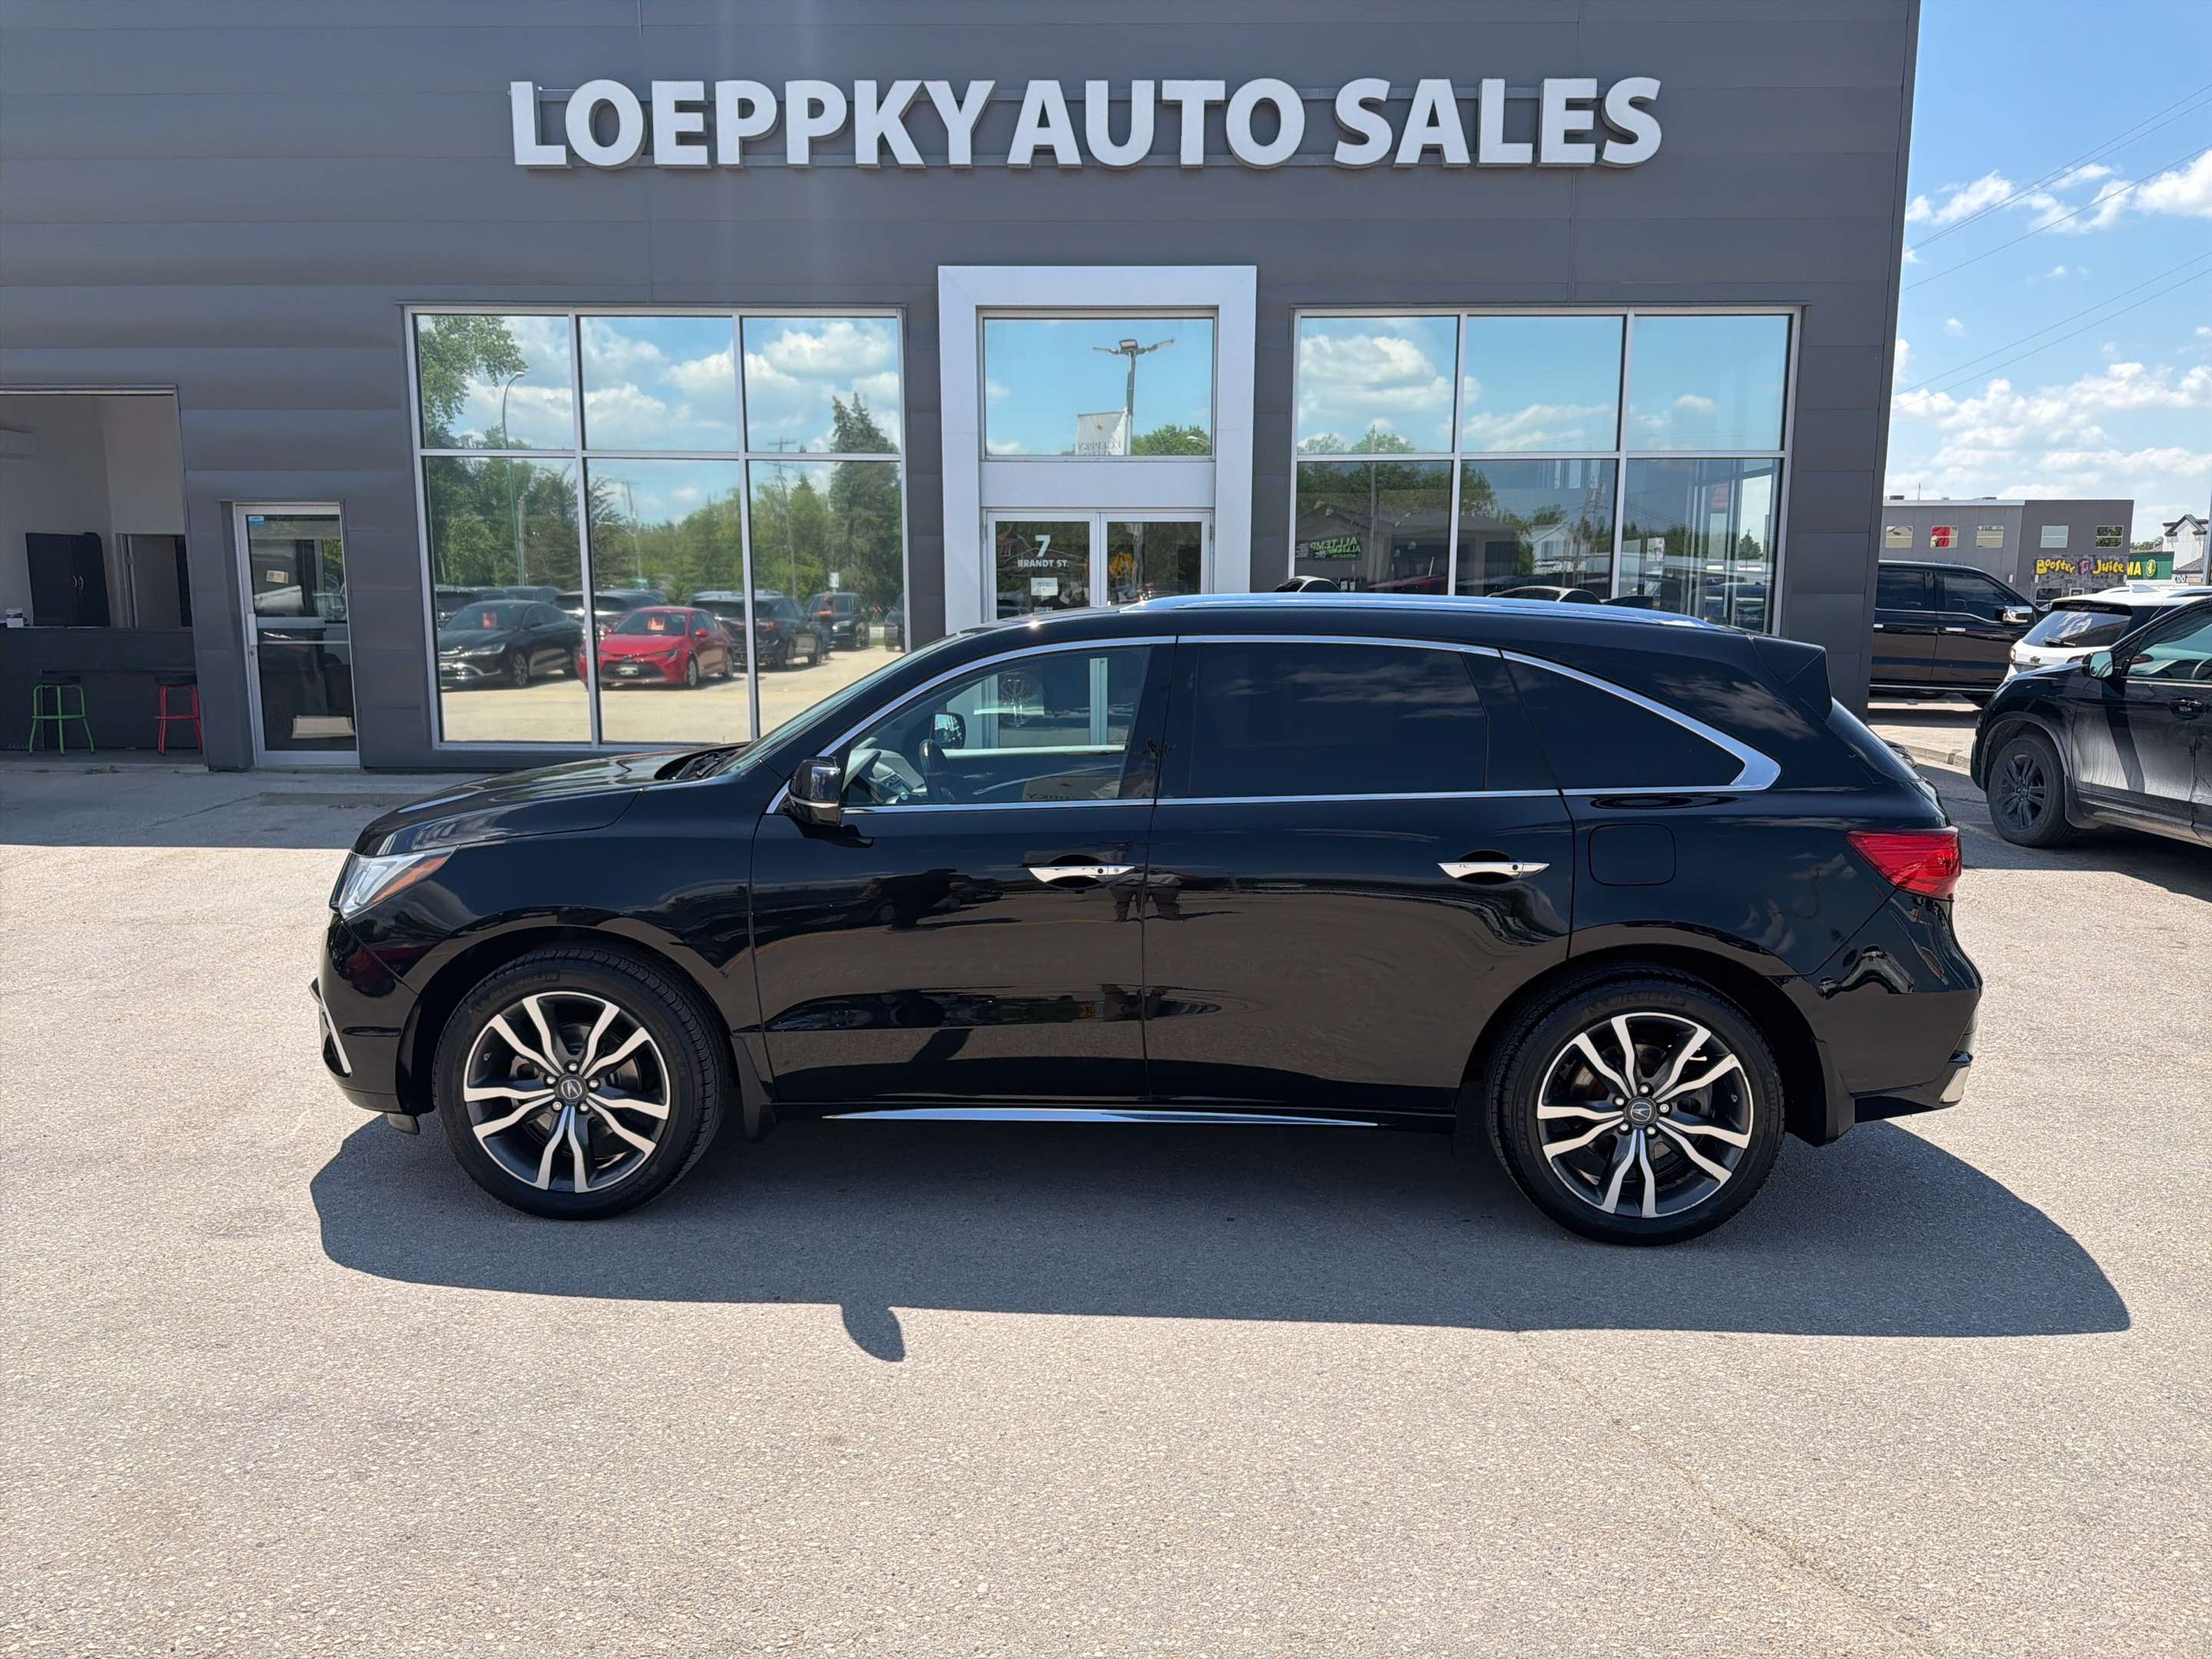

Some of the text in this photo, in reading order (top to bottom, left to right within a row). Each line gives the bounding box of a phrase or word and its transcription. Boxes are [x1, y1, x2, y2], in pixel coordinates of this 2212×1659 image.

[509, 77, 1663, 168] LOEPPKY AUTO SALES
[1035, 535, 1051, 558] 7
[1017, 558, 1070, 568] BRANDT ST.
[2036, 558, 2075, 575] Booster
[2091, 558, 2124, 575] Juice
